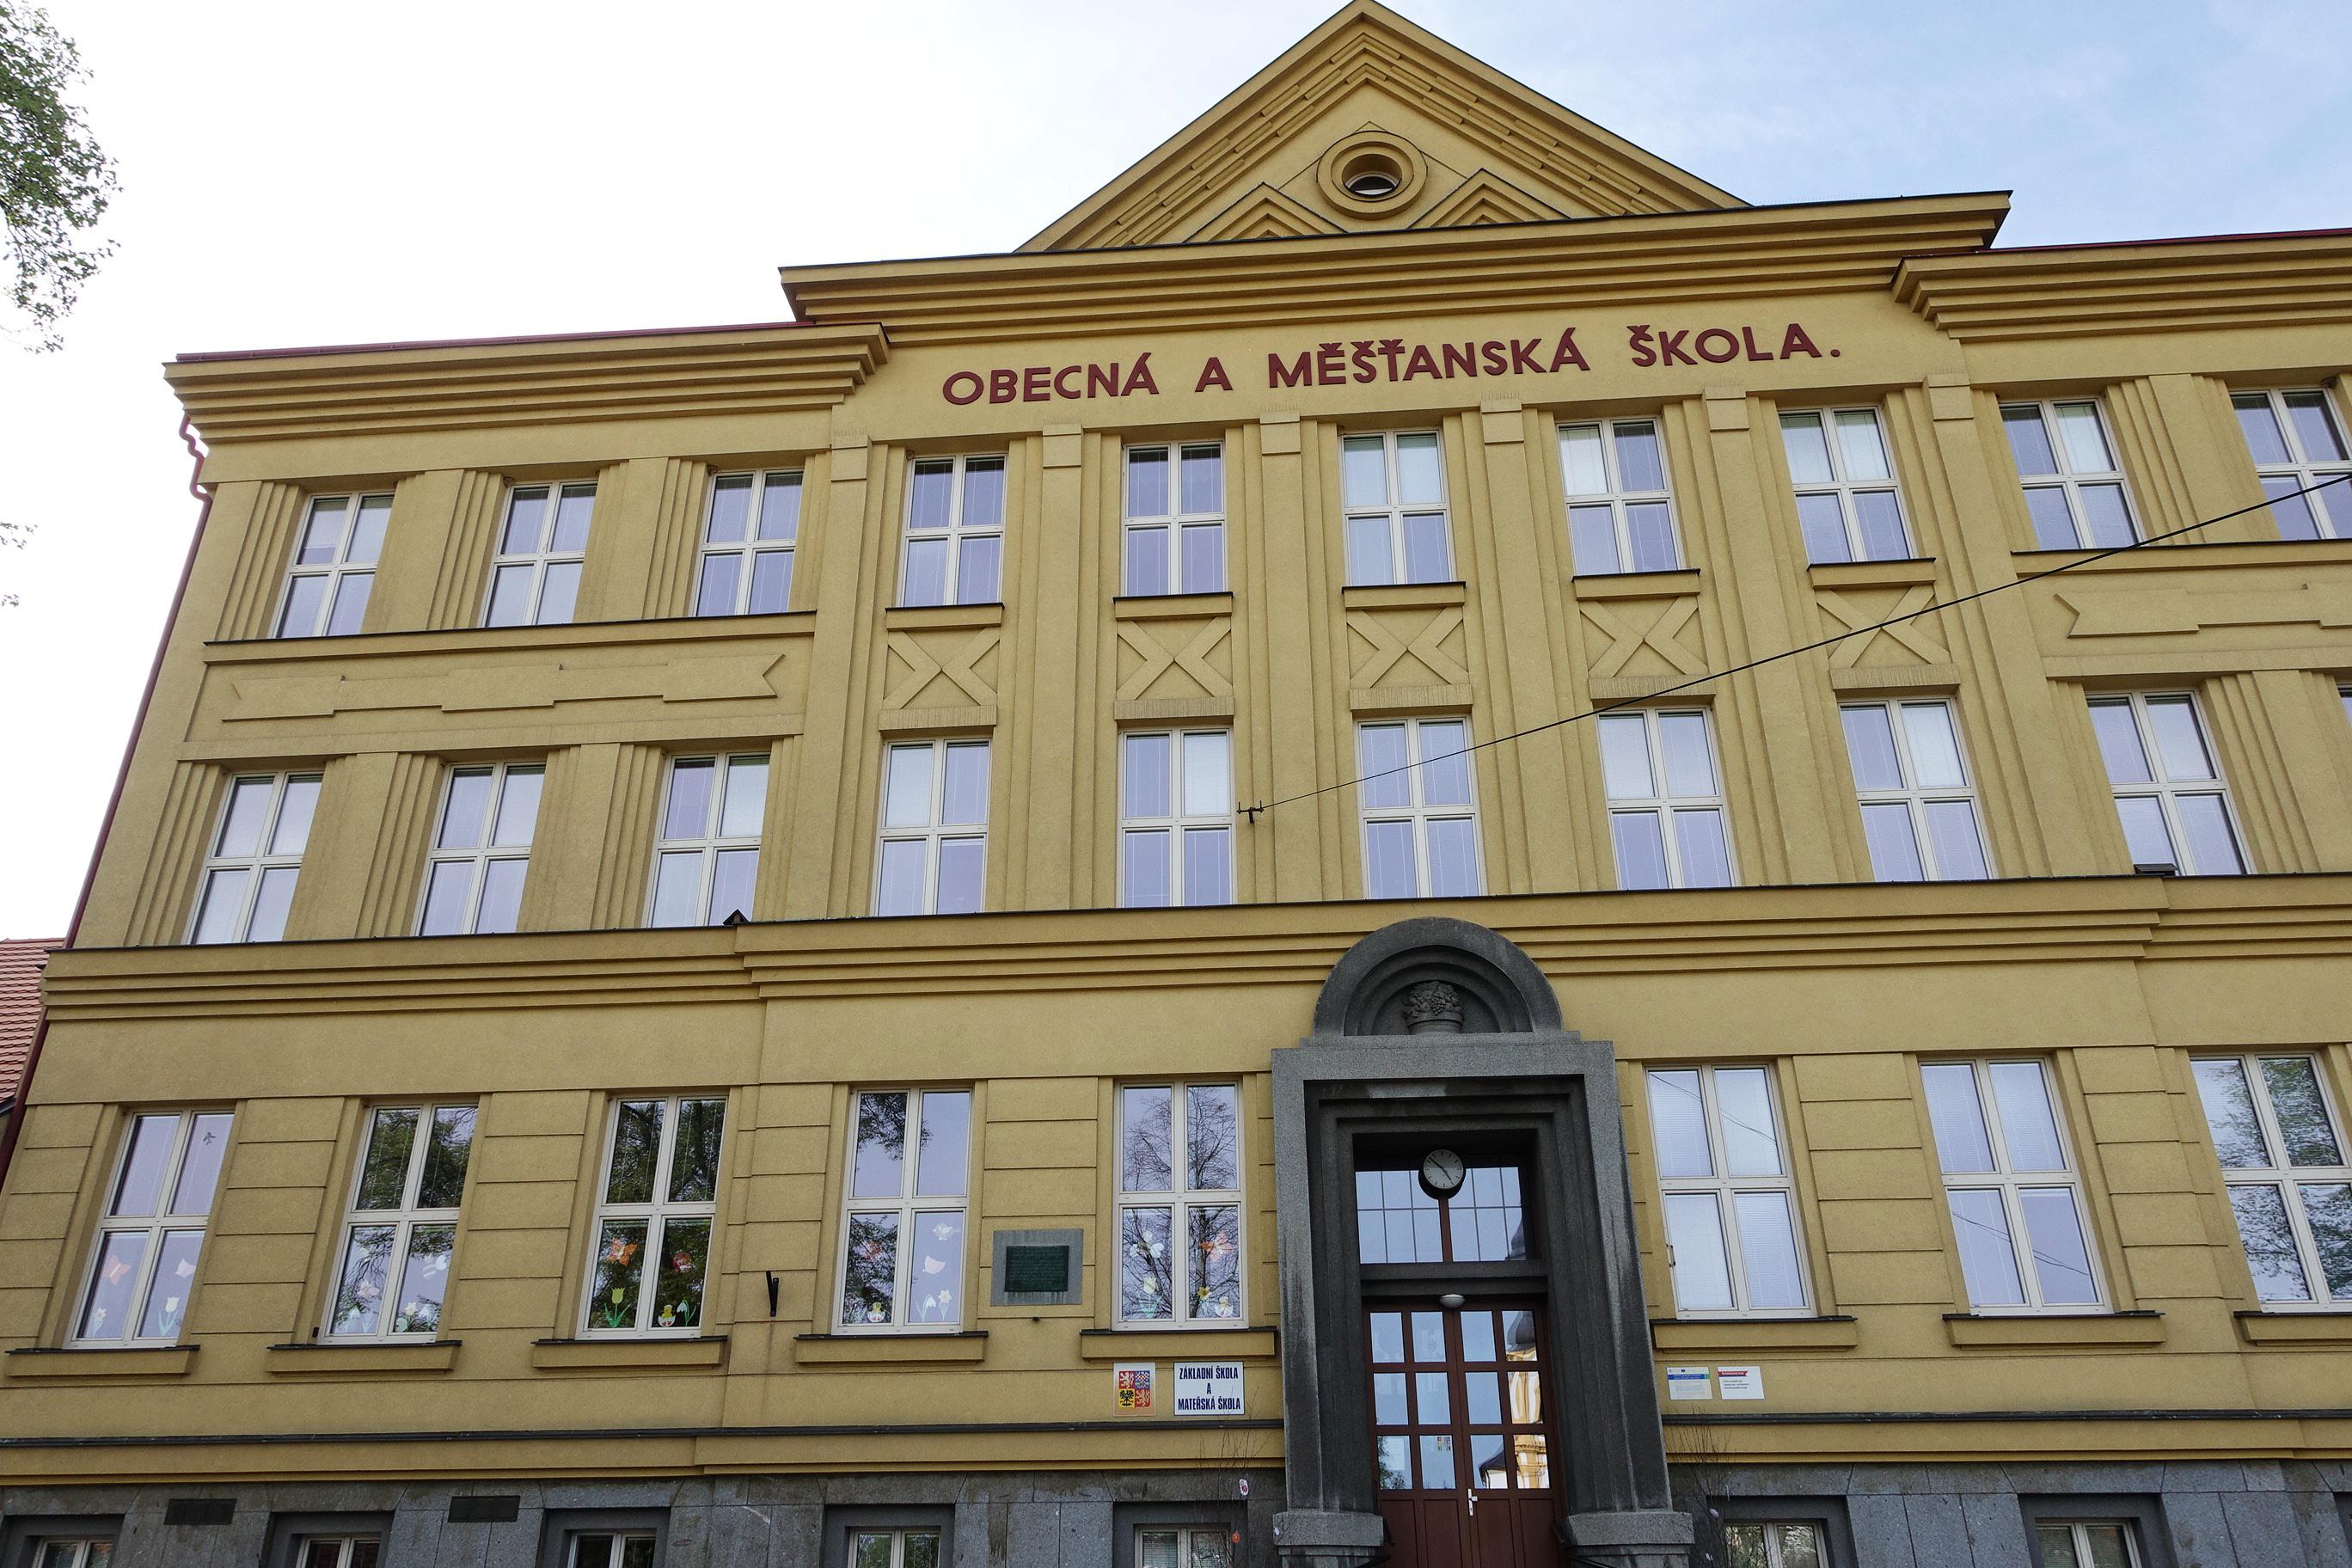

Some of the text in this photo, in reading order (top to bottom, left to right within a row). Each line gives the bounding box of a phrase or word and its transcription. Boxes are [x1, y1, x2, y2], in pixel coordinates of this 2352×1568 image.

[942, 322, 1843, 406] OBECNÁ A MĚŠŤANSKÁ ŠKOLA.
[1179, 1365, 1239, 1380] ZÁKLADNÍ ŠKOLA
[1206, 1382, 1211, 1394] A
[1178, 1396, 1240, 1411] MATEŘSKÁ ŠKOLA
